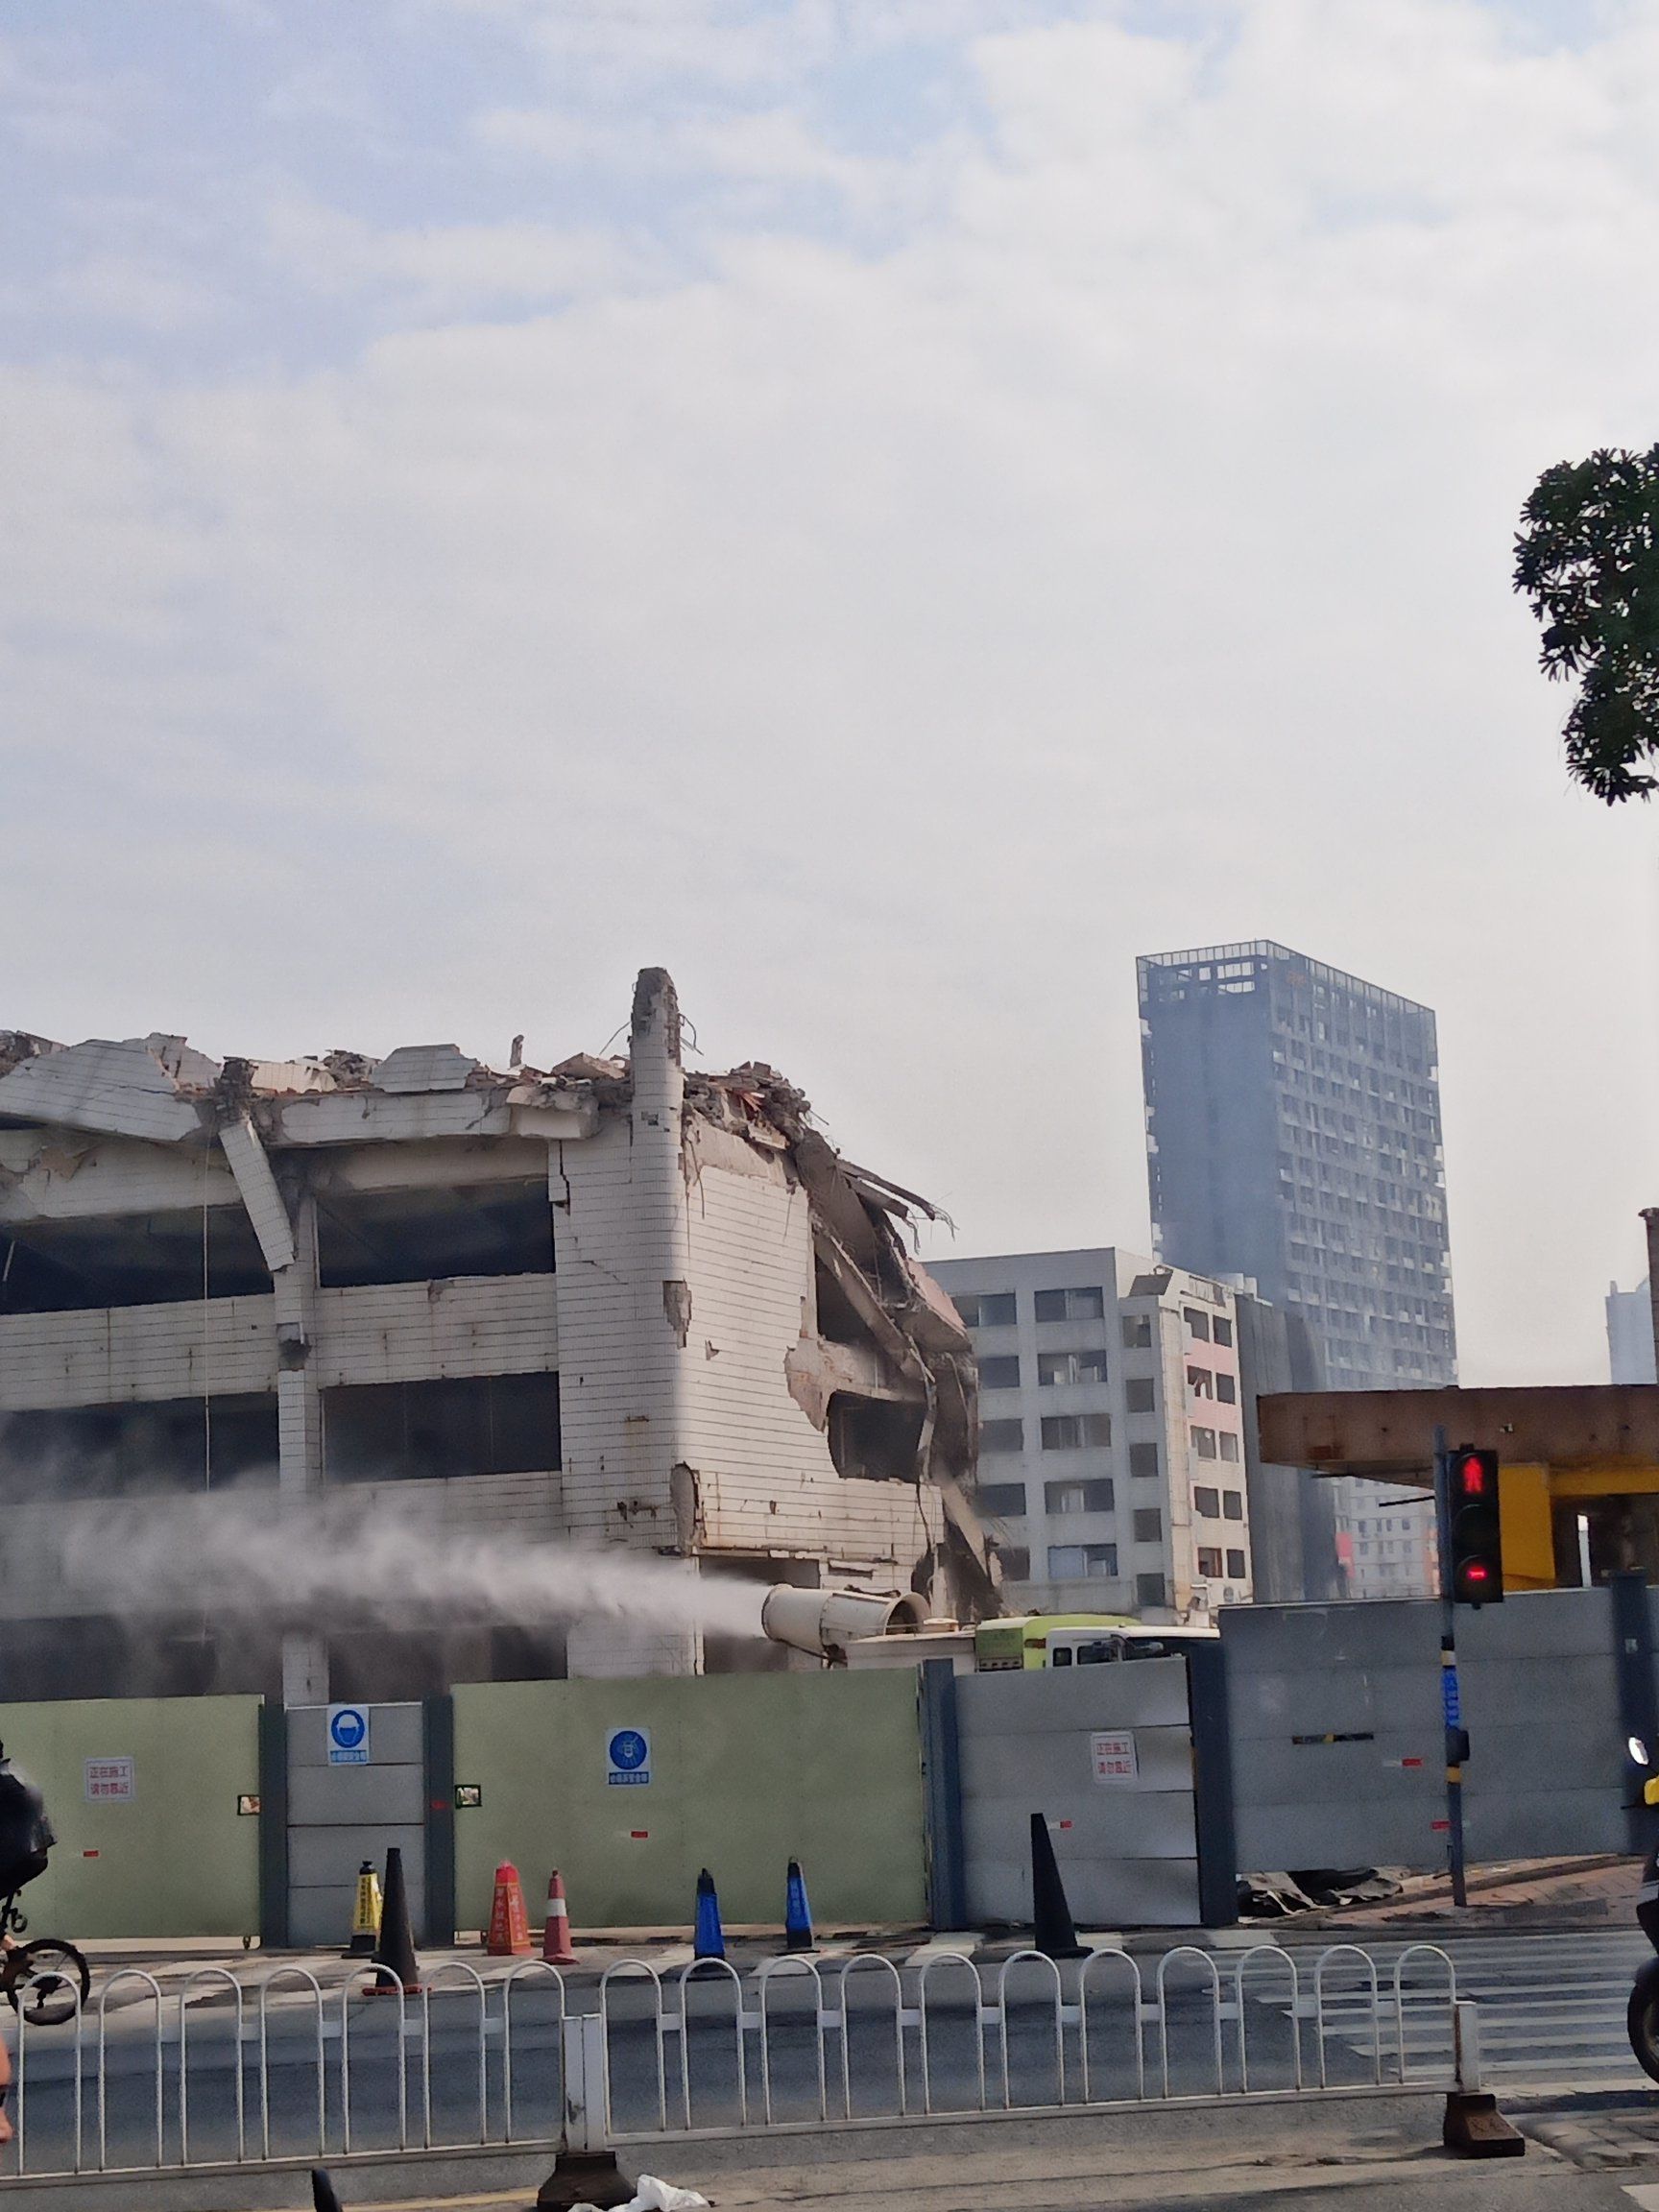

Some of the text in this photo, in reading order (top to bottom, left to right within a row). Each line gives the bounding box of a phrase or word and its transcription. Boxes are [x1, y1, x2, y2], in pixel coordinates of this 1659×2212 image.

[1096, 1742, 1130, 1755] 正在施工
[89, 1766, 129, 1778] 正在施工
